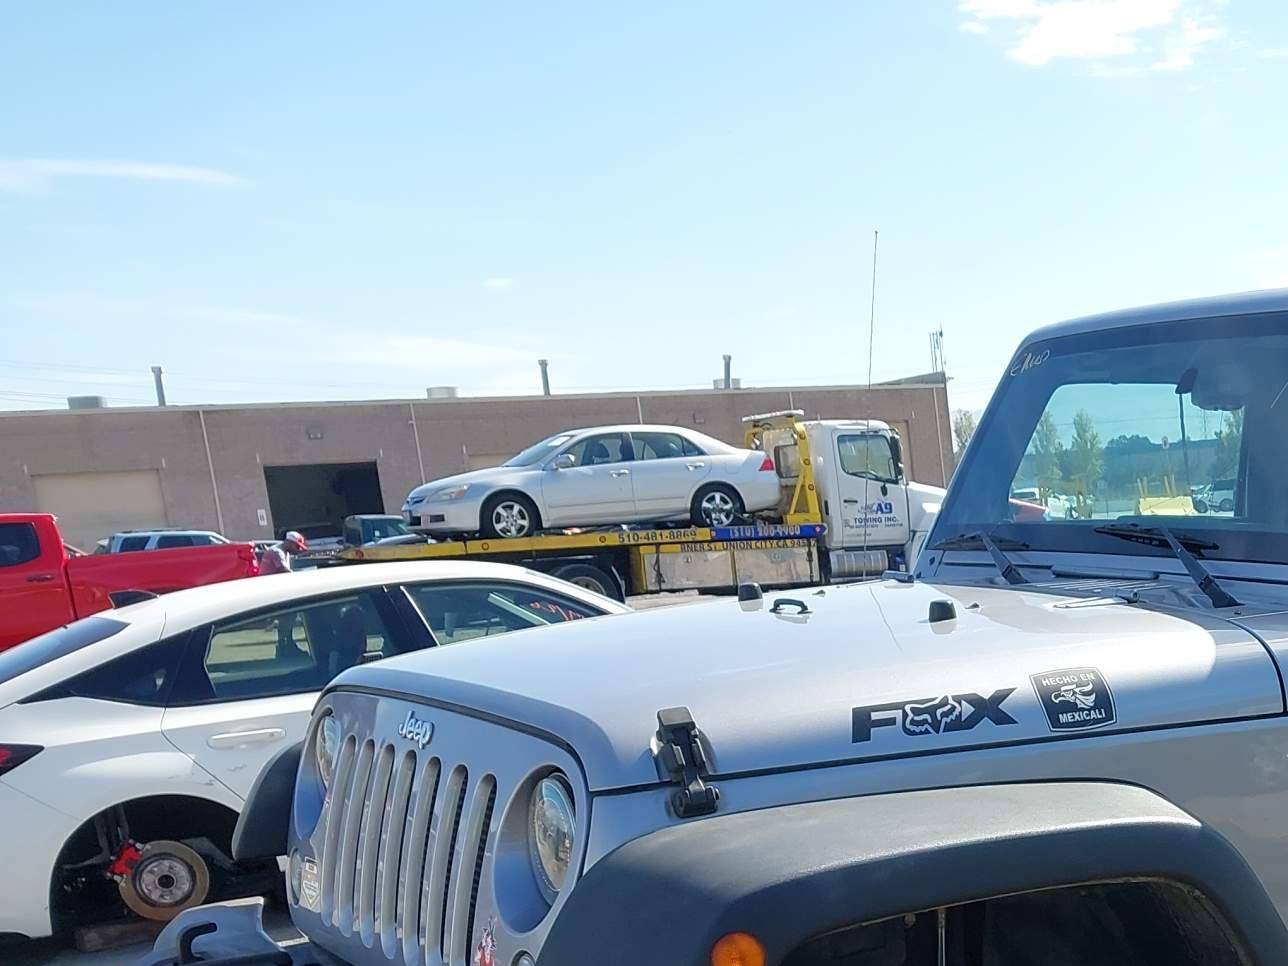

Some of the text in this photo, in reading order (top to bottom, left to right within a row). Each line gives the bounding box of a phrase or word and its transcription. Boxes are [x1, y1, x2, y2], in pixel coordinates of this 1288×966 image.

[722, 541, 752, 551] UNION
[755, 540, 774, 549] CITY
[776, 539, 788, 548] CA
[1042, 672, 1096, 687] HECHO EN
[1058, 709, 1106, 724] MEXICALI
[398, 710, 433, 750] Jeep
